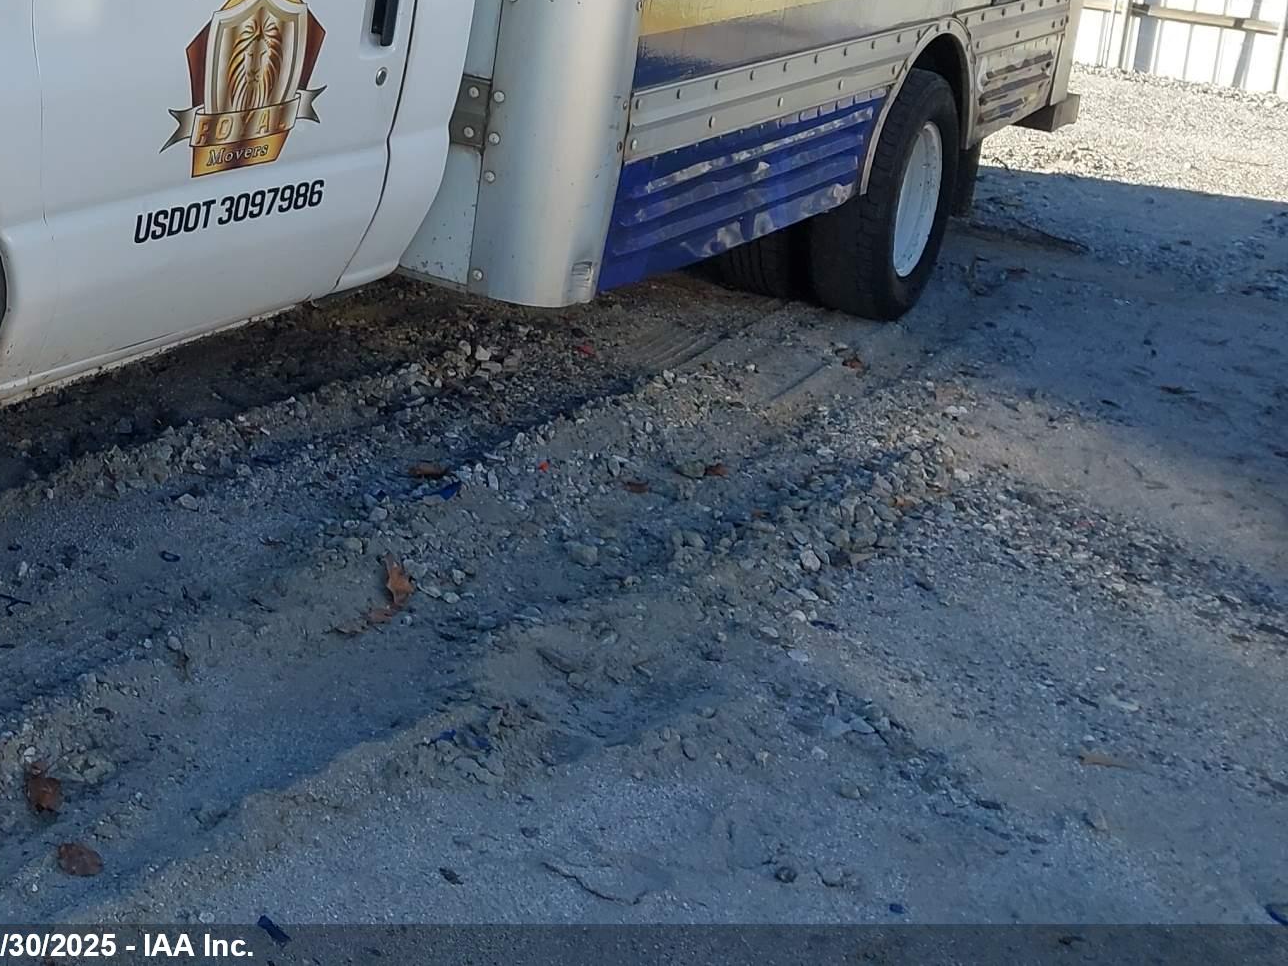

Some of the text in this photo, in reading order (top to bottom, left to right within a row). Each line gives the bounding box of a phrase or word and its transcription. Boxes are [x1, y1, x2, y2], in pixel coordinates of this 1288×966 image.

[206, 144, 269, 166] Movers
[134, 179, 325, 244] USDOT 3097986
